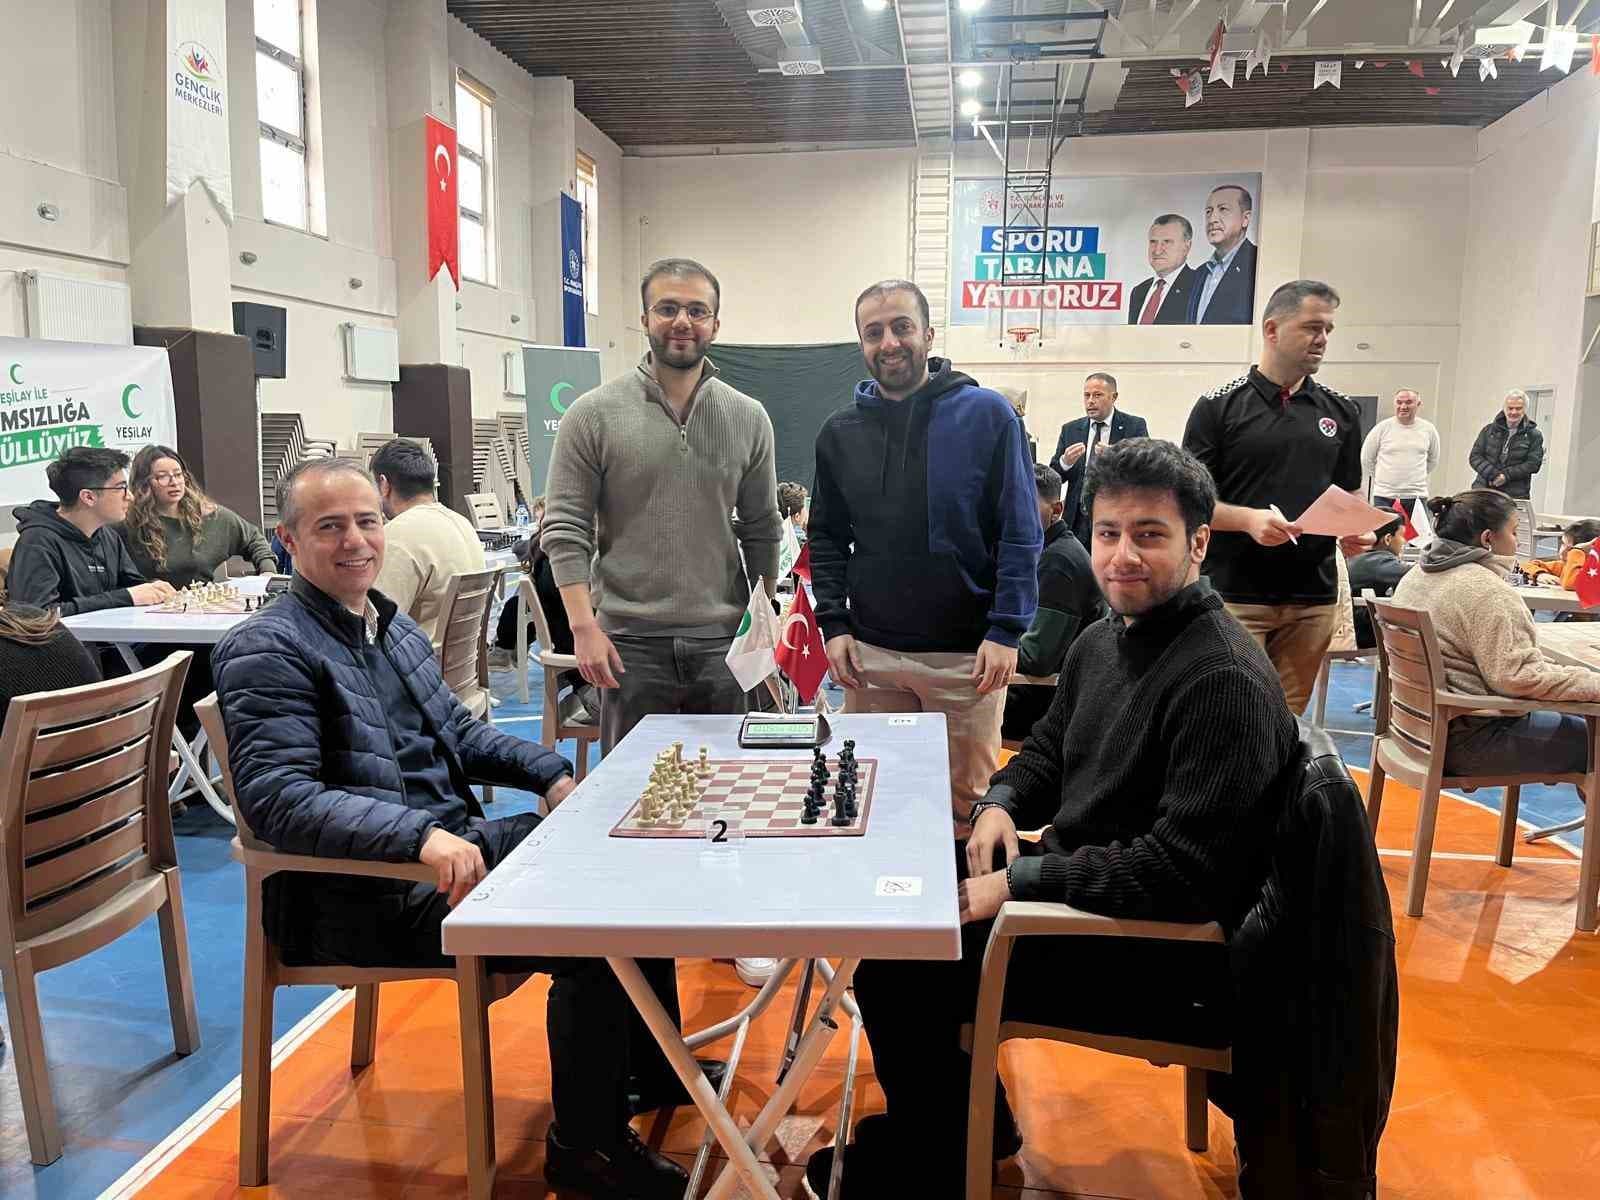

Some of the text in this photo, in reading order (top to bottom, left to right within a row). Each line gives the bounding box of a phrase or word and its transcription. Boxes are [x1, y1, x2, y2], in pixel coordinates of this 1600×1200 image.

[991, 230, 1084, 252] SPORU
[983, 255, 1095, 280] TABANA
[966, 283, 1118, 308] YAYIYORUZ
[34, 385, 48, 401] İLE
[115, 425, 152, 440] YEŞİLAY
[711, 819, 728, 843] 2
